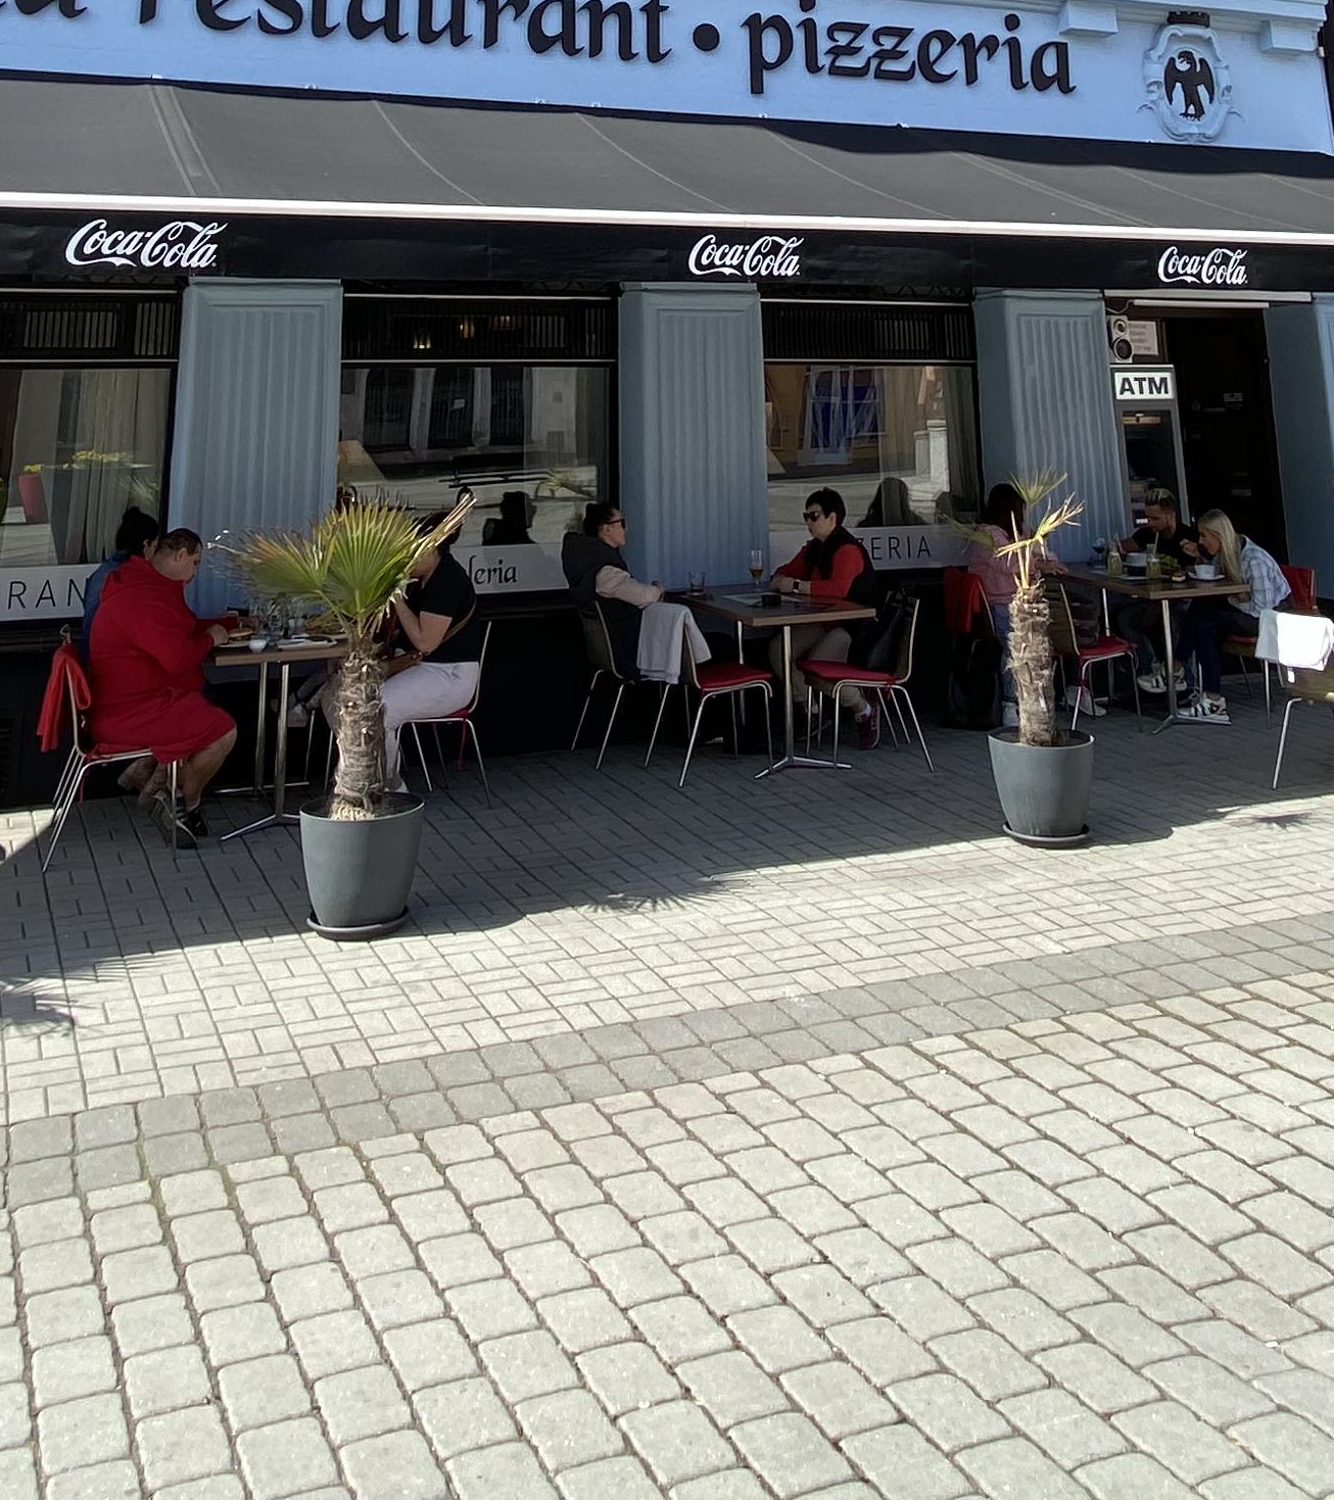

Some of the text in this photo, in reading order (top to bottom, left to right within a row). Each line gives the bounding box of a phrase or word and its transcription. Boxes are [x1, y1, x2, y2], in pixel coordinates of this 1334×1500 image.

[65, 218, 228, 268] Coca-Cola
[688, 234, 805, 277] Coca-Cola
[1157, 246, 1248, 285] Coca-Cola
[1119, 376, 1169, 396] ATM
